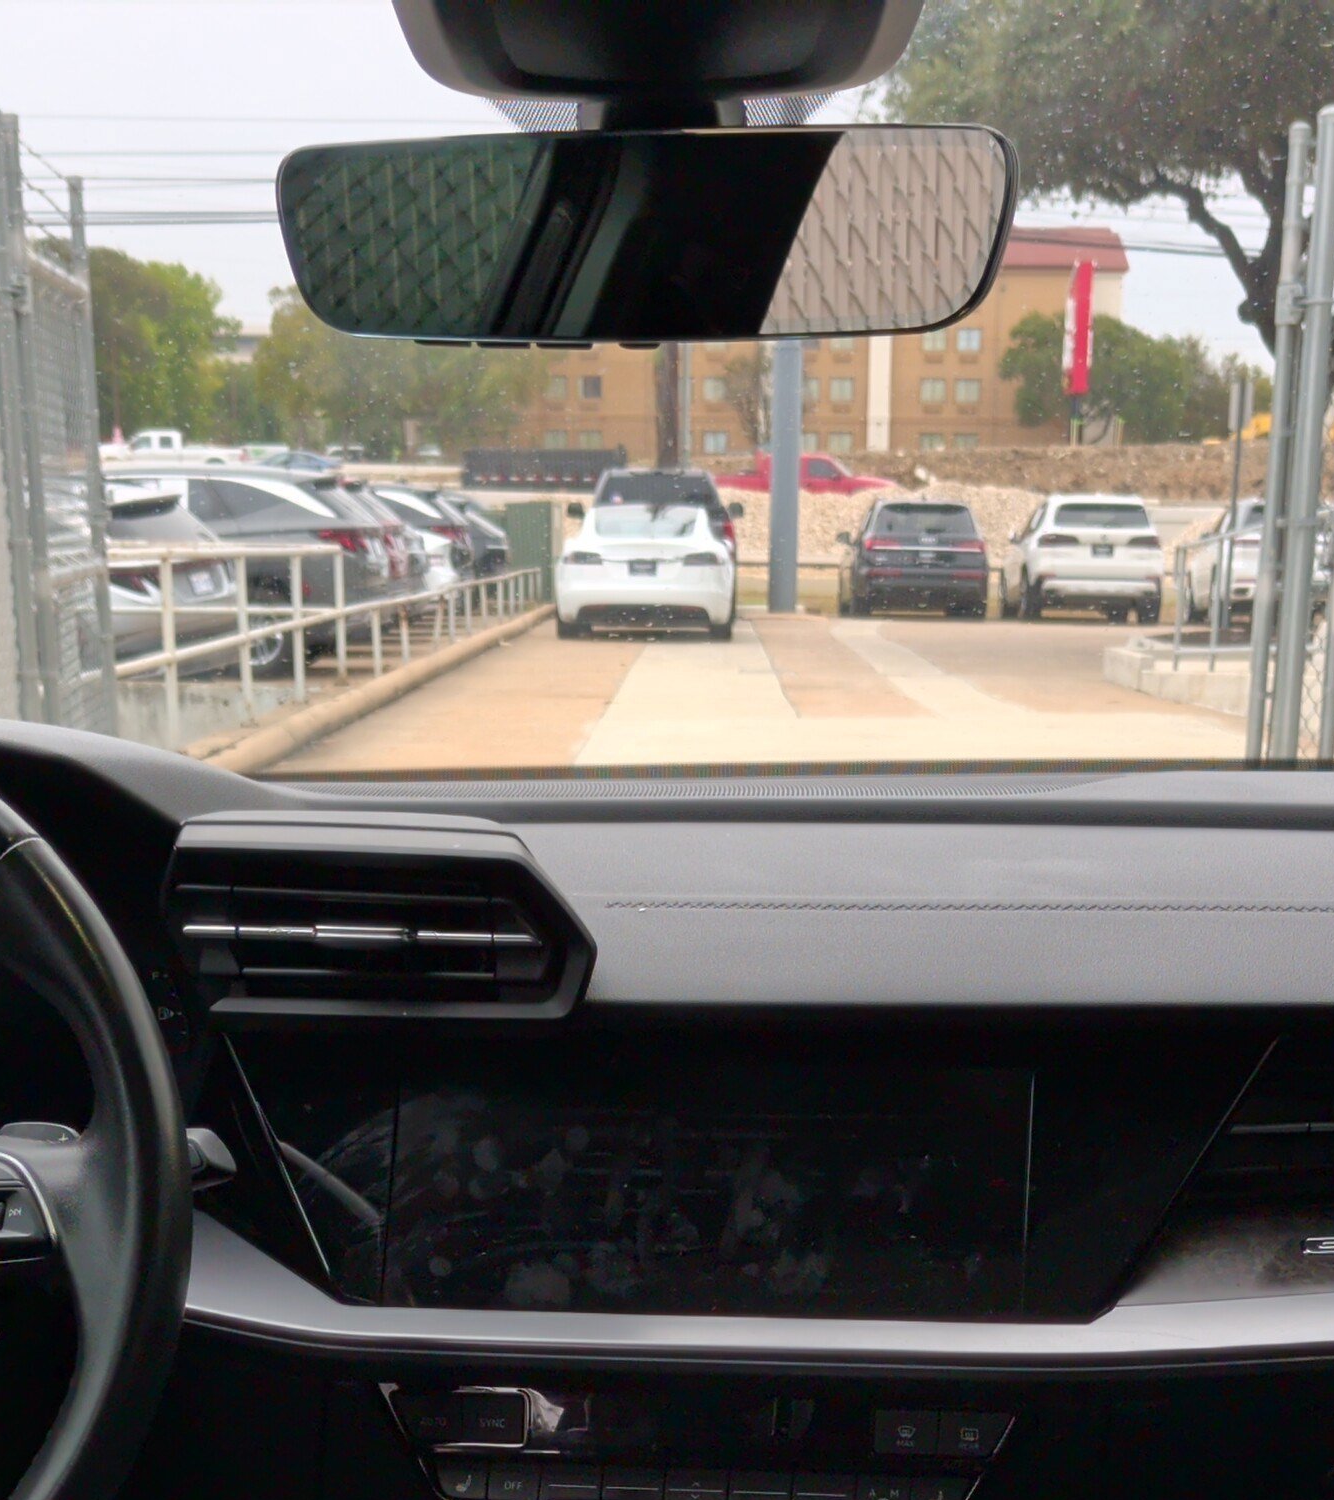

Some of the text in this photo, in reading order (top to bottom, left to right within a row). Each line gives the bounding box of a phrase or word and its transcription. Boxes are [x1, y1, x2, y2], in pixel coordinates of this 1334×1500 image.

[478, 1418, 506, 1429] SYNC
[504, 1481, 523, 1490] OFF
[890, 1489, 899, 1498] M
